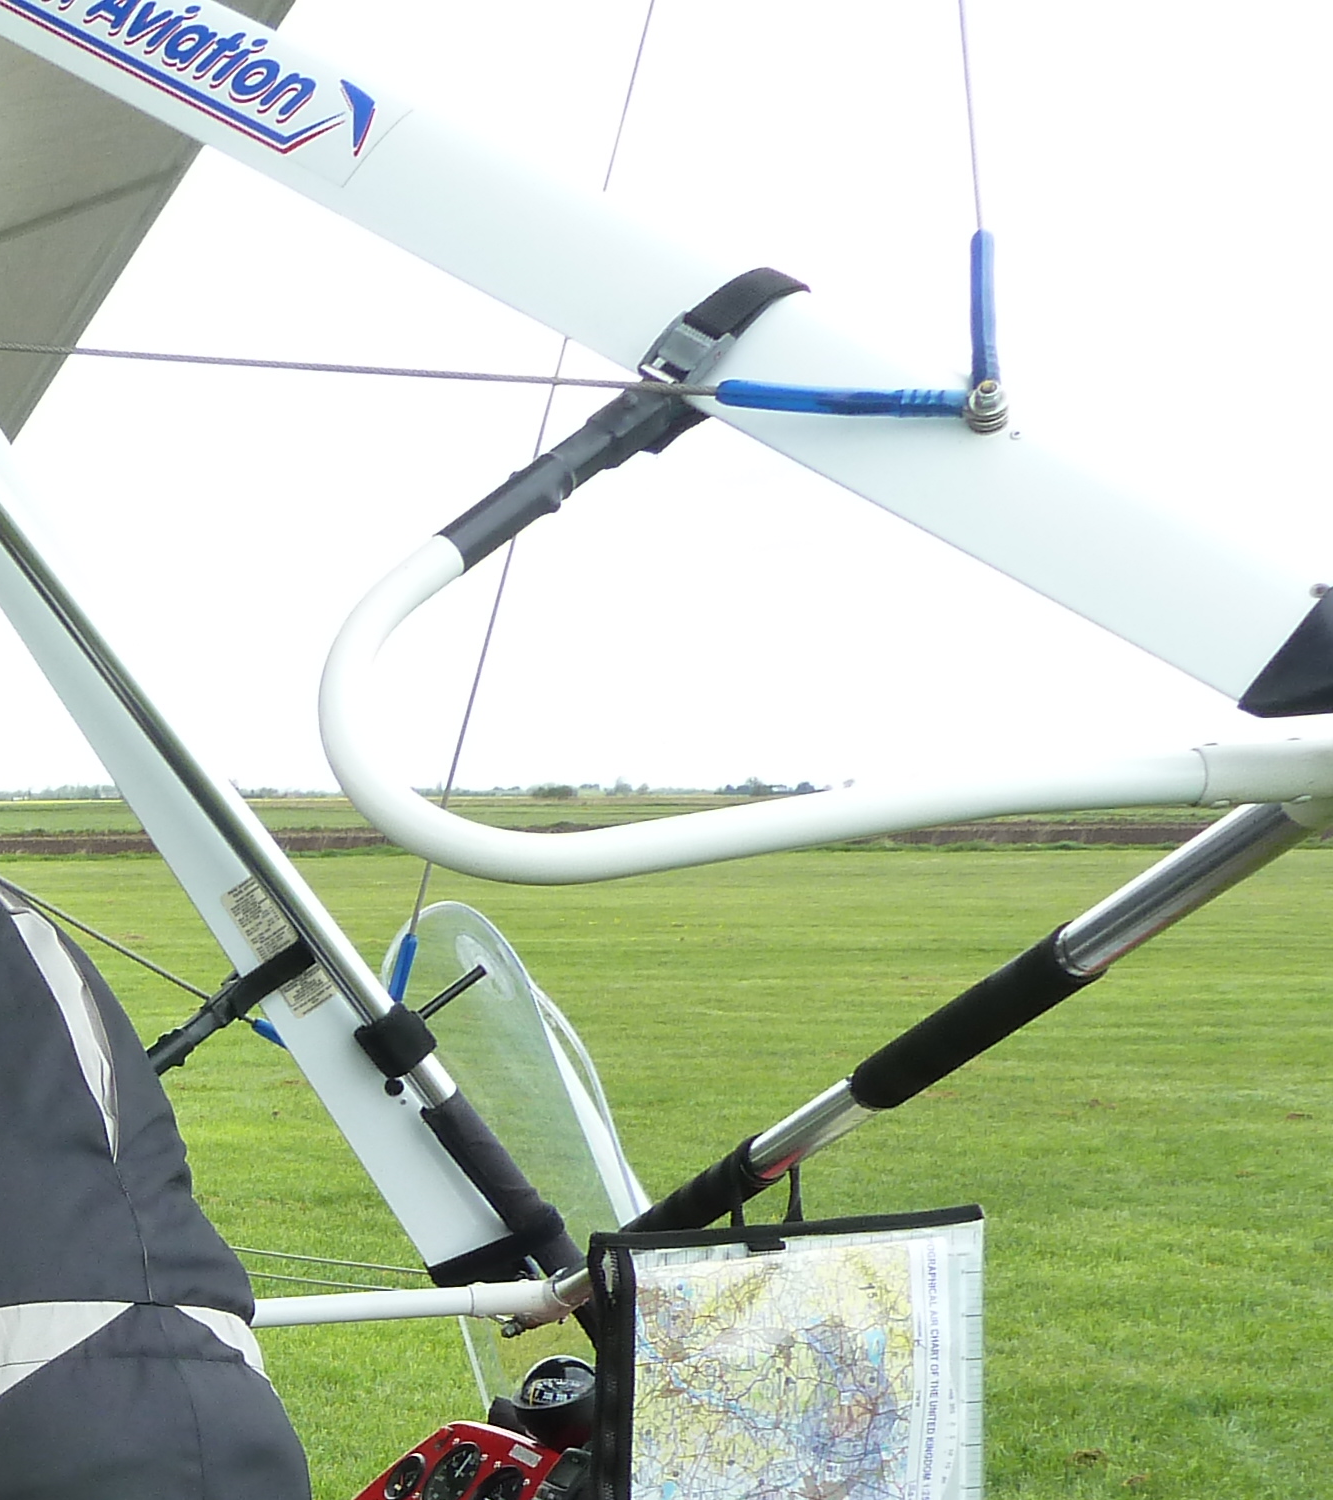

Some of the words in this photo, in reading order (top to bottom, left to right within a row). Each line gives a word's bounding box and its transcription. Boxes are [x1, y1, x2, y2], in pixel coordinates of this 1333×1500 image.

[83, 0, 317, 124] Aviation
[930, 1329, 940, 1361] CHART
[930, 1364, 940, 1377] OF
[929, 1381, 939, 1398] THE
[926, 1401, 939, 1435] UNITED
[922, 1437, 935, 1480] KINGDOM
